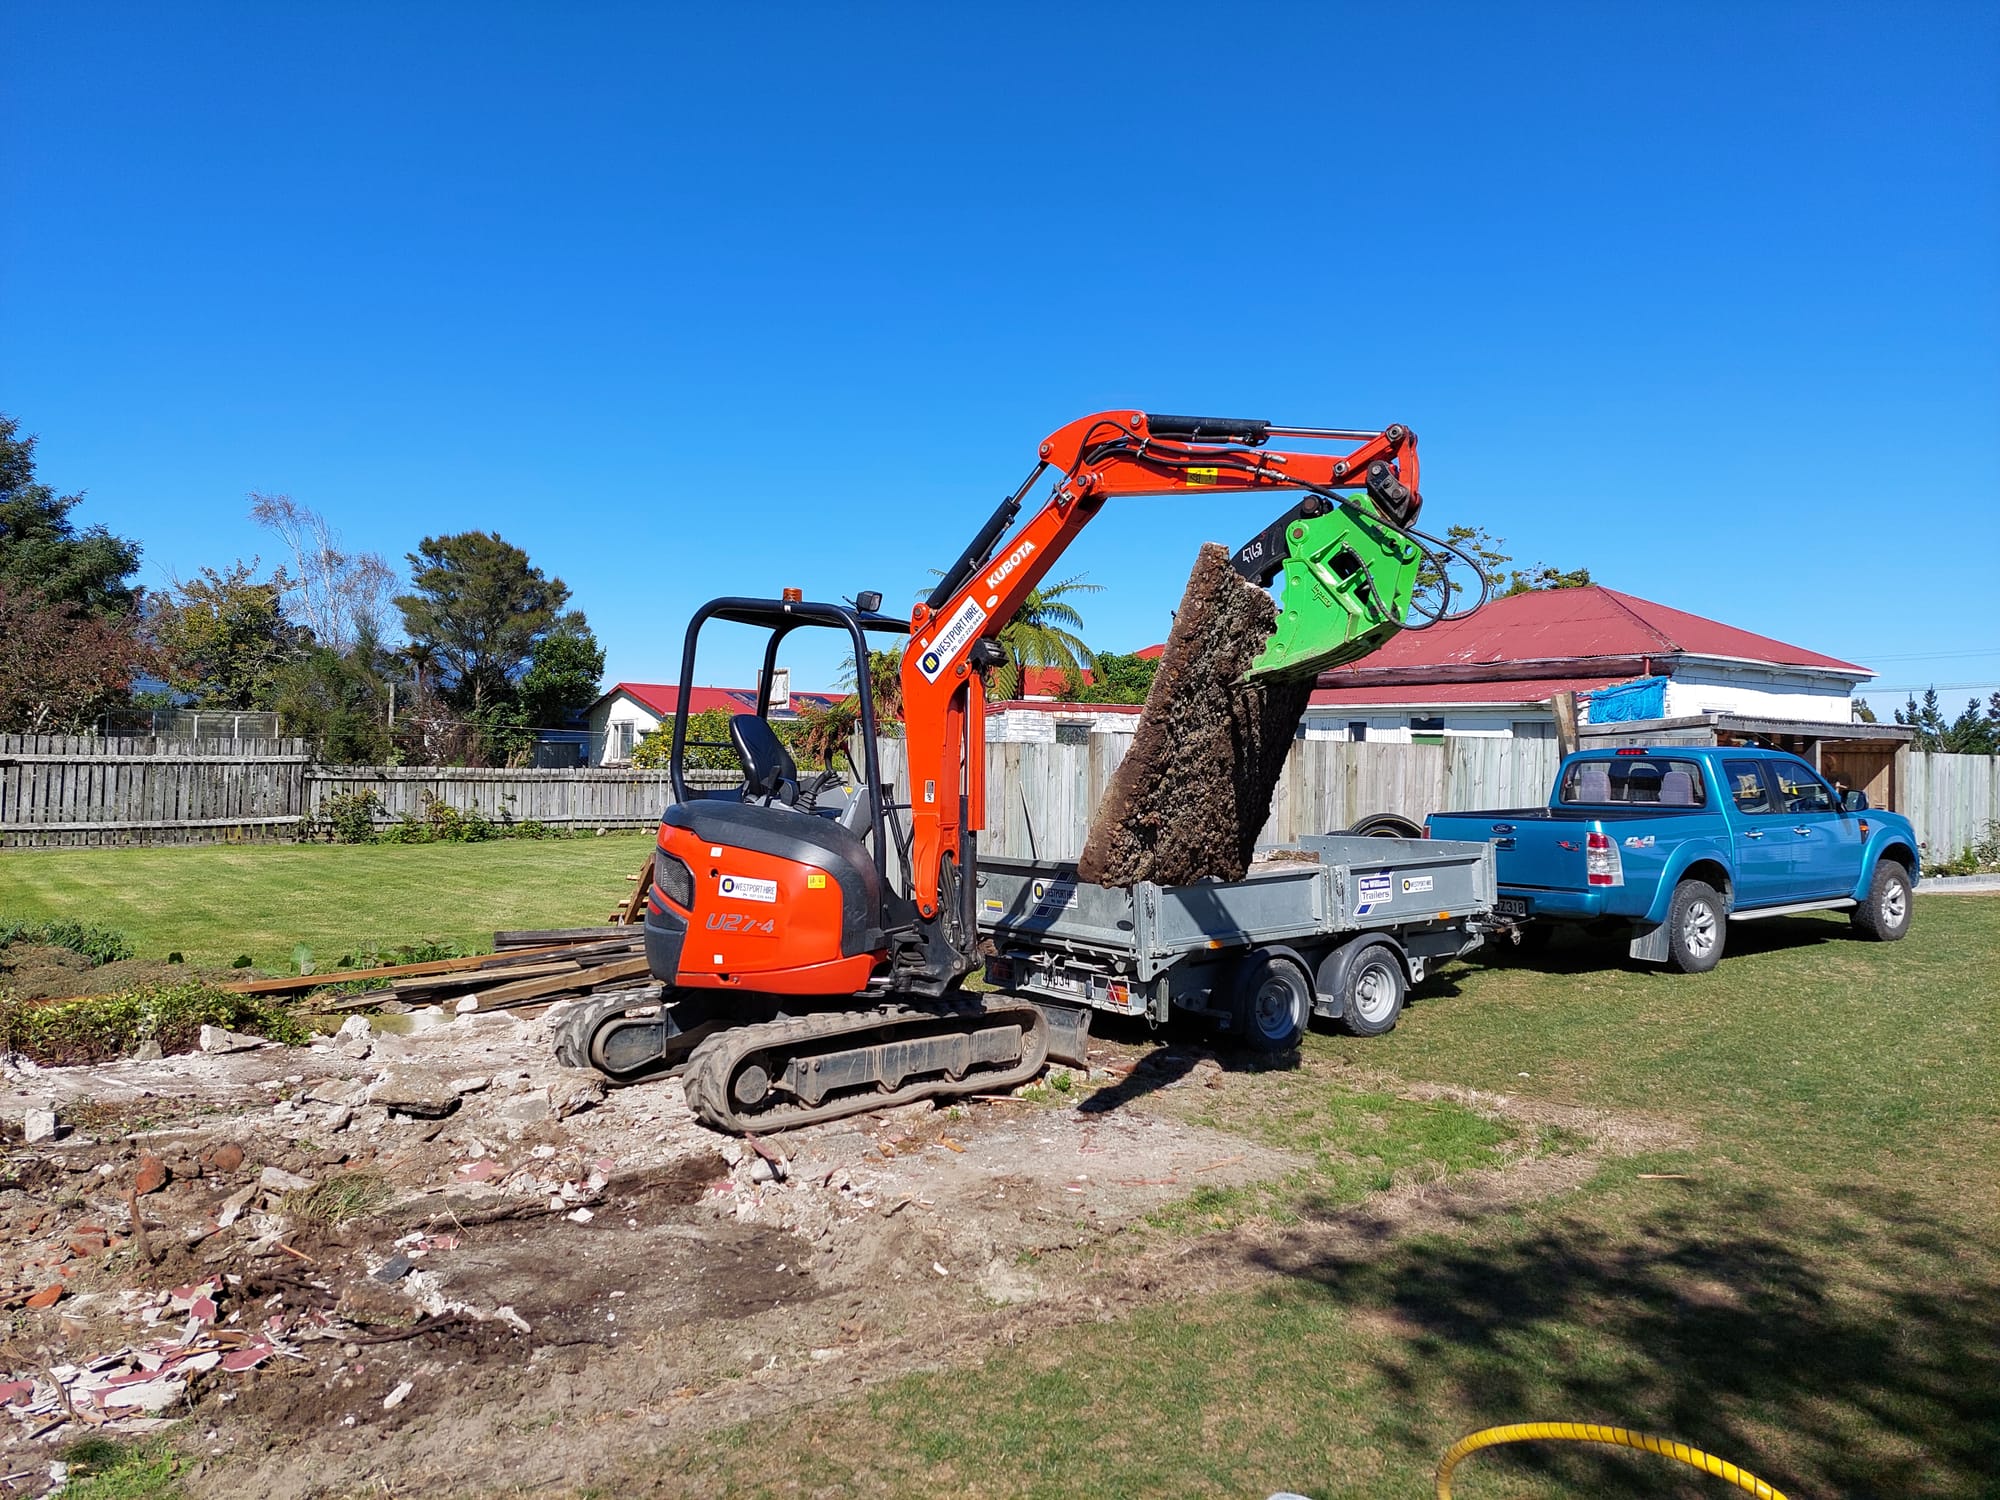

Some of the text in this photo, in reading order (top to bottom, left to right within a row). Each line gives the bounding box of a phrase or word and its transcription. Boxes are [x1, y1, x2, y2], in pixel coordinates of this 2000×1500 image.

[985, 541, 1035, 589] KUBOTA
[934, 603, 980, 657] WESTPORT HIRE
[735, 883, 775, 895] WESTPORT HIRE
[1362, 890, 1389, 900] Trailers
[706, 913, 774, 933] U27-4
